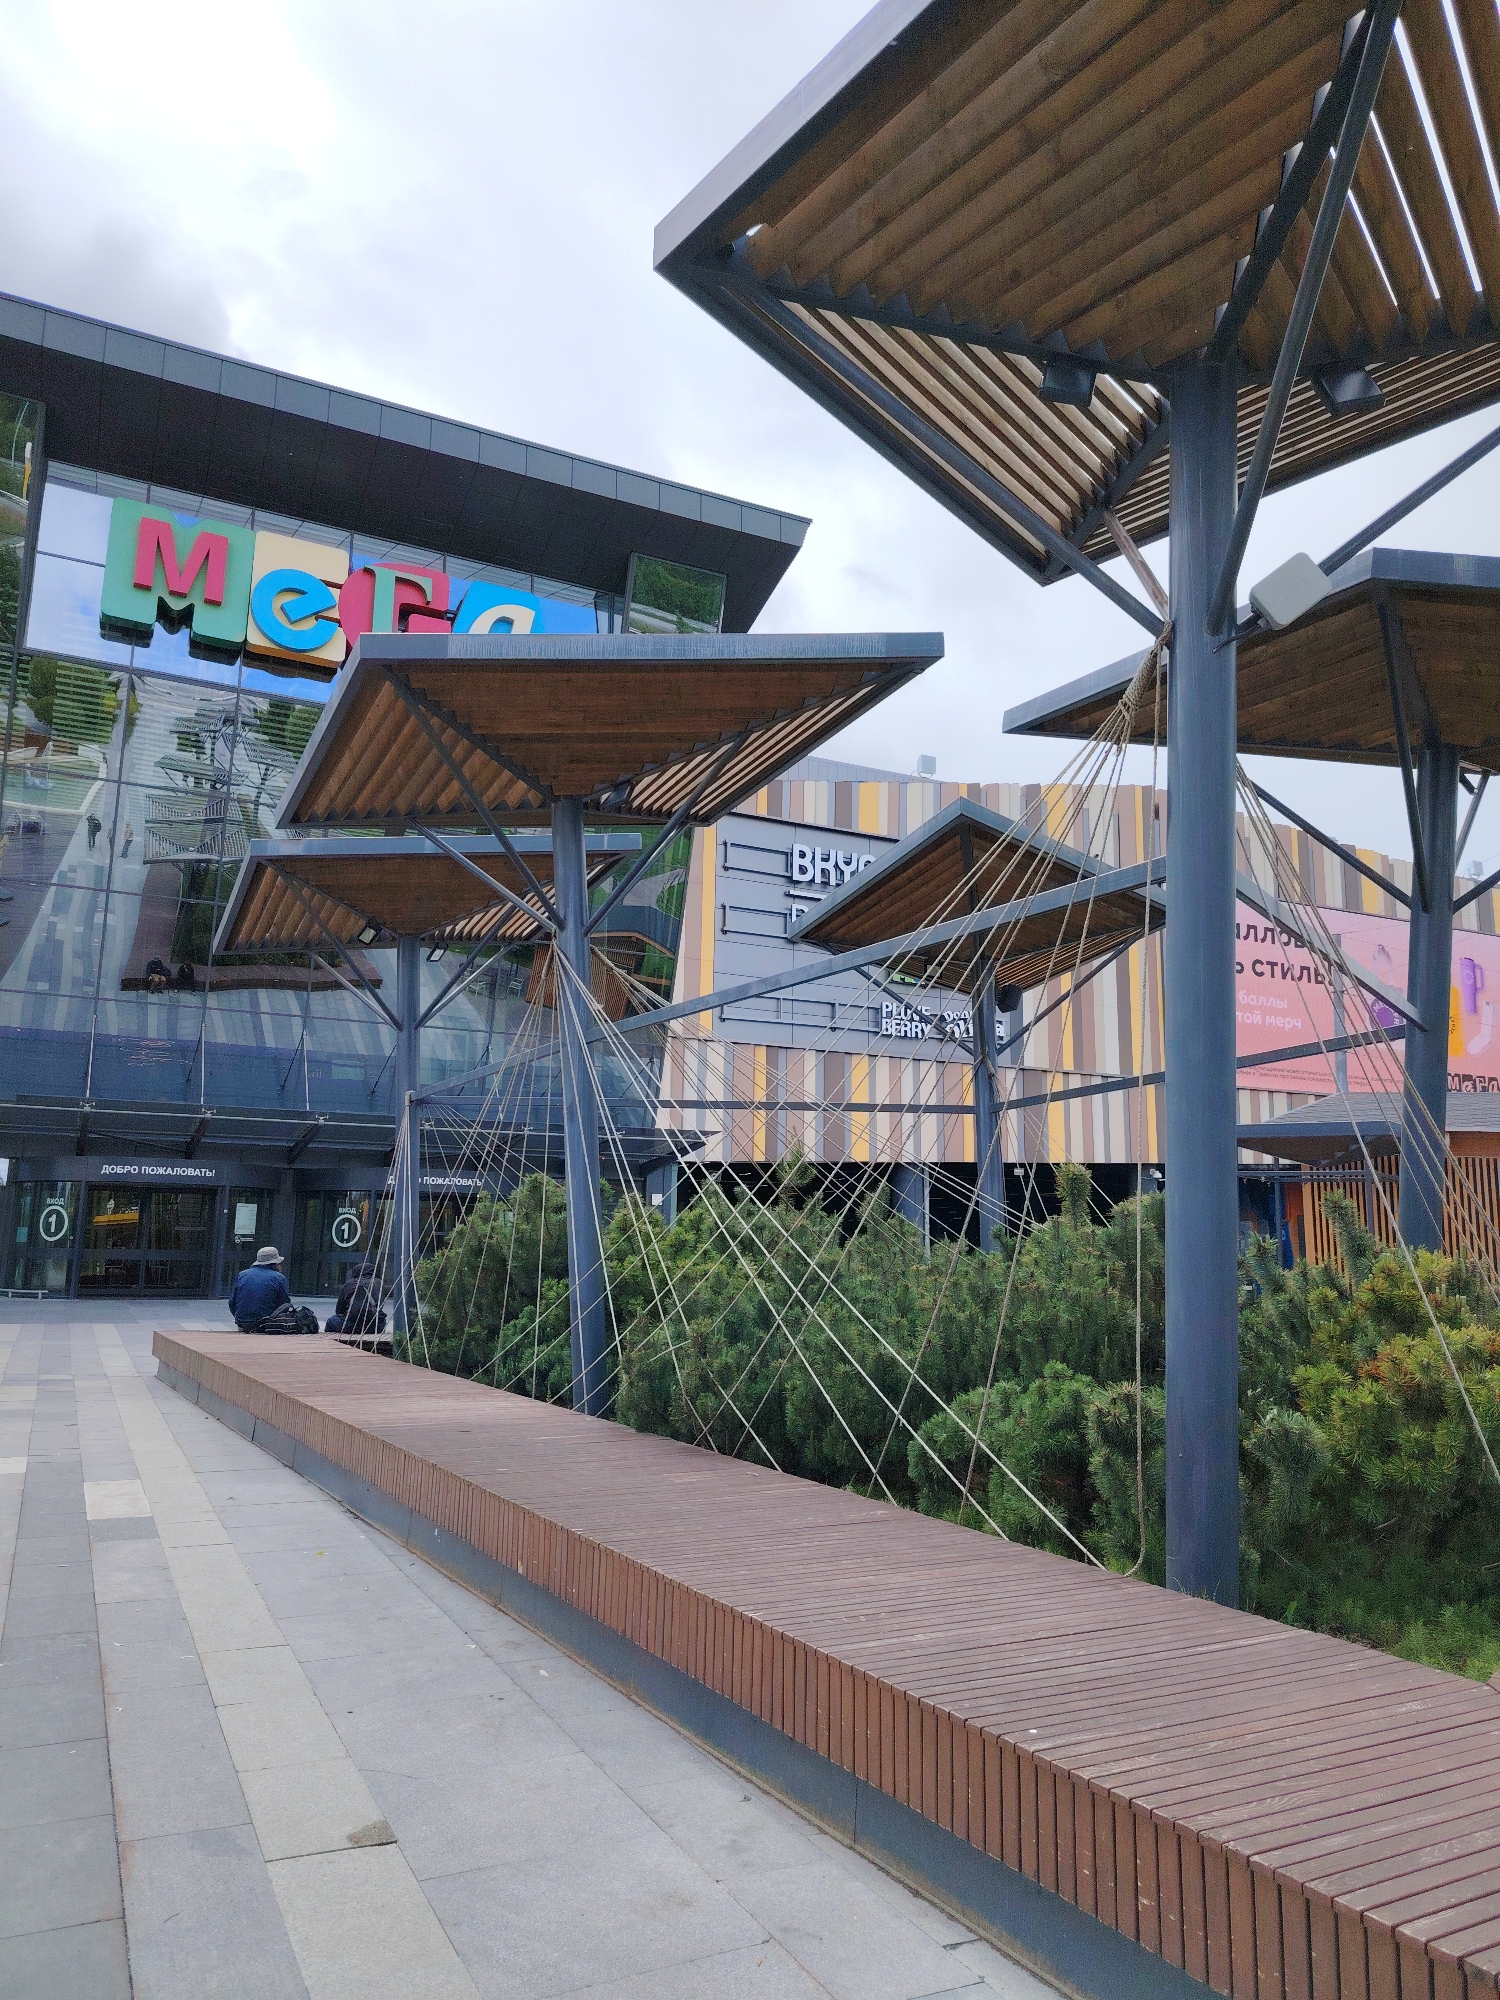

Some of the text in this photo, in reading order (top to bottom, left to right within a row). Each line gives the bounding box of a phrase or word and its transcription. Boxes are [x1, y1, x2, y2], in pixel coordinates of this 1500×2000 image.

[1238, 990, 1287, 1009] баллы
[881, 1018, 932, 1040] BERRY
[1265, 1015, 1302, 1031] мерч
[101, 1165, 216, 1177] ДОБРО ПОЖАЛОВАТЬ!
[46, 1197, 65, 1206] ВХОД
[338, 1207, 357, 1215] ВХОД
[48, 1213, 57, 1233] 1
[341, 1222, 350, 1240] 1
